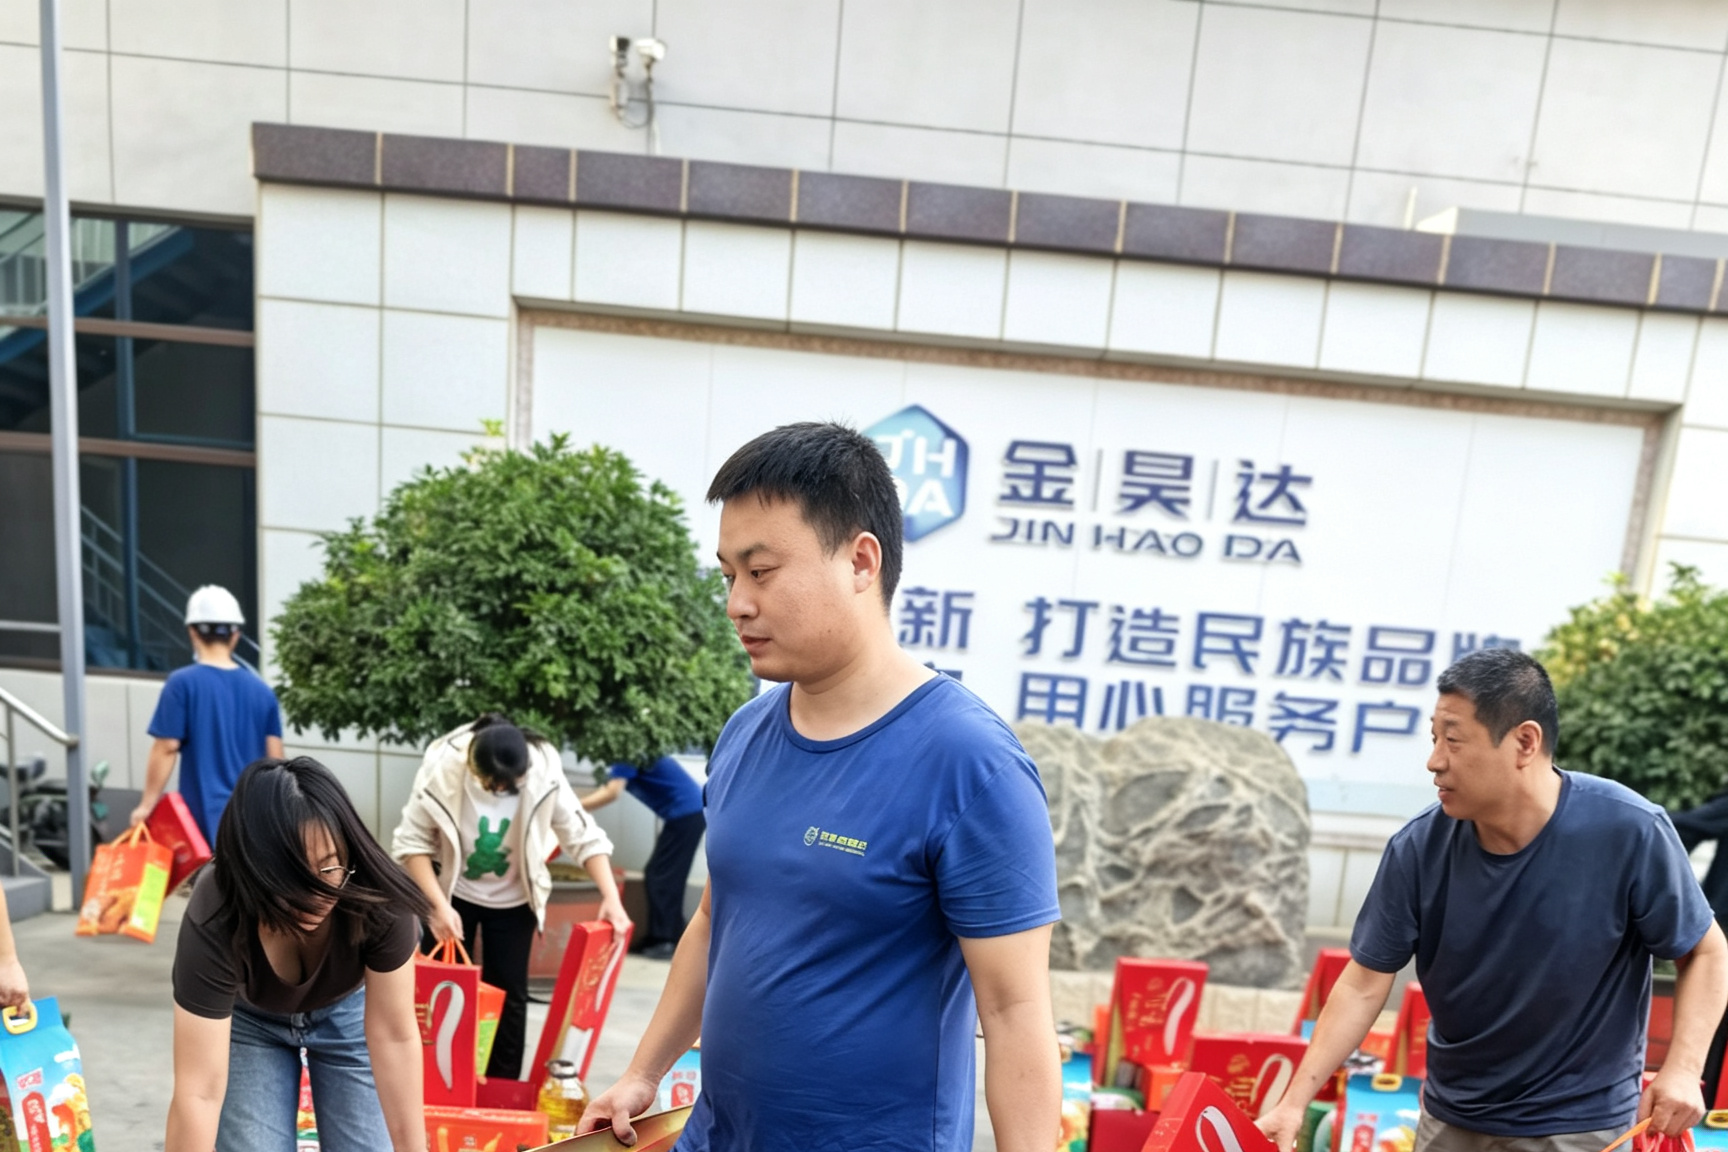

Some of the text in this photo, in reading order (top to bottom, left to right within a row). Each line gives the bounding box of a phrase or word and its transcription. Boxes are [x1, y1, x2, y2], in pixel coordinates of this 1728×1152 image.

[1000, 440, 1313, 526] 金昊达
[989, 517, 1302, 564] JIN HAO DA
[900, 586, 975, 650] 新
